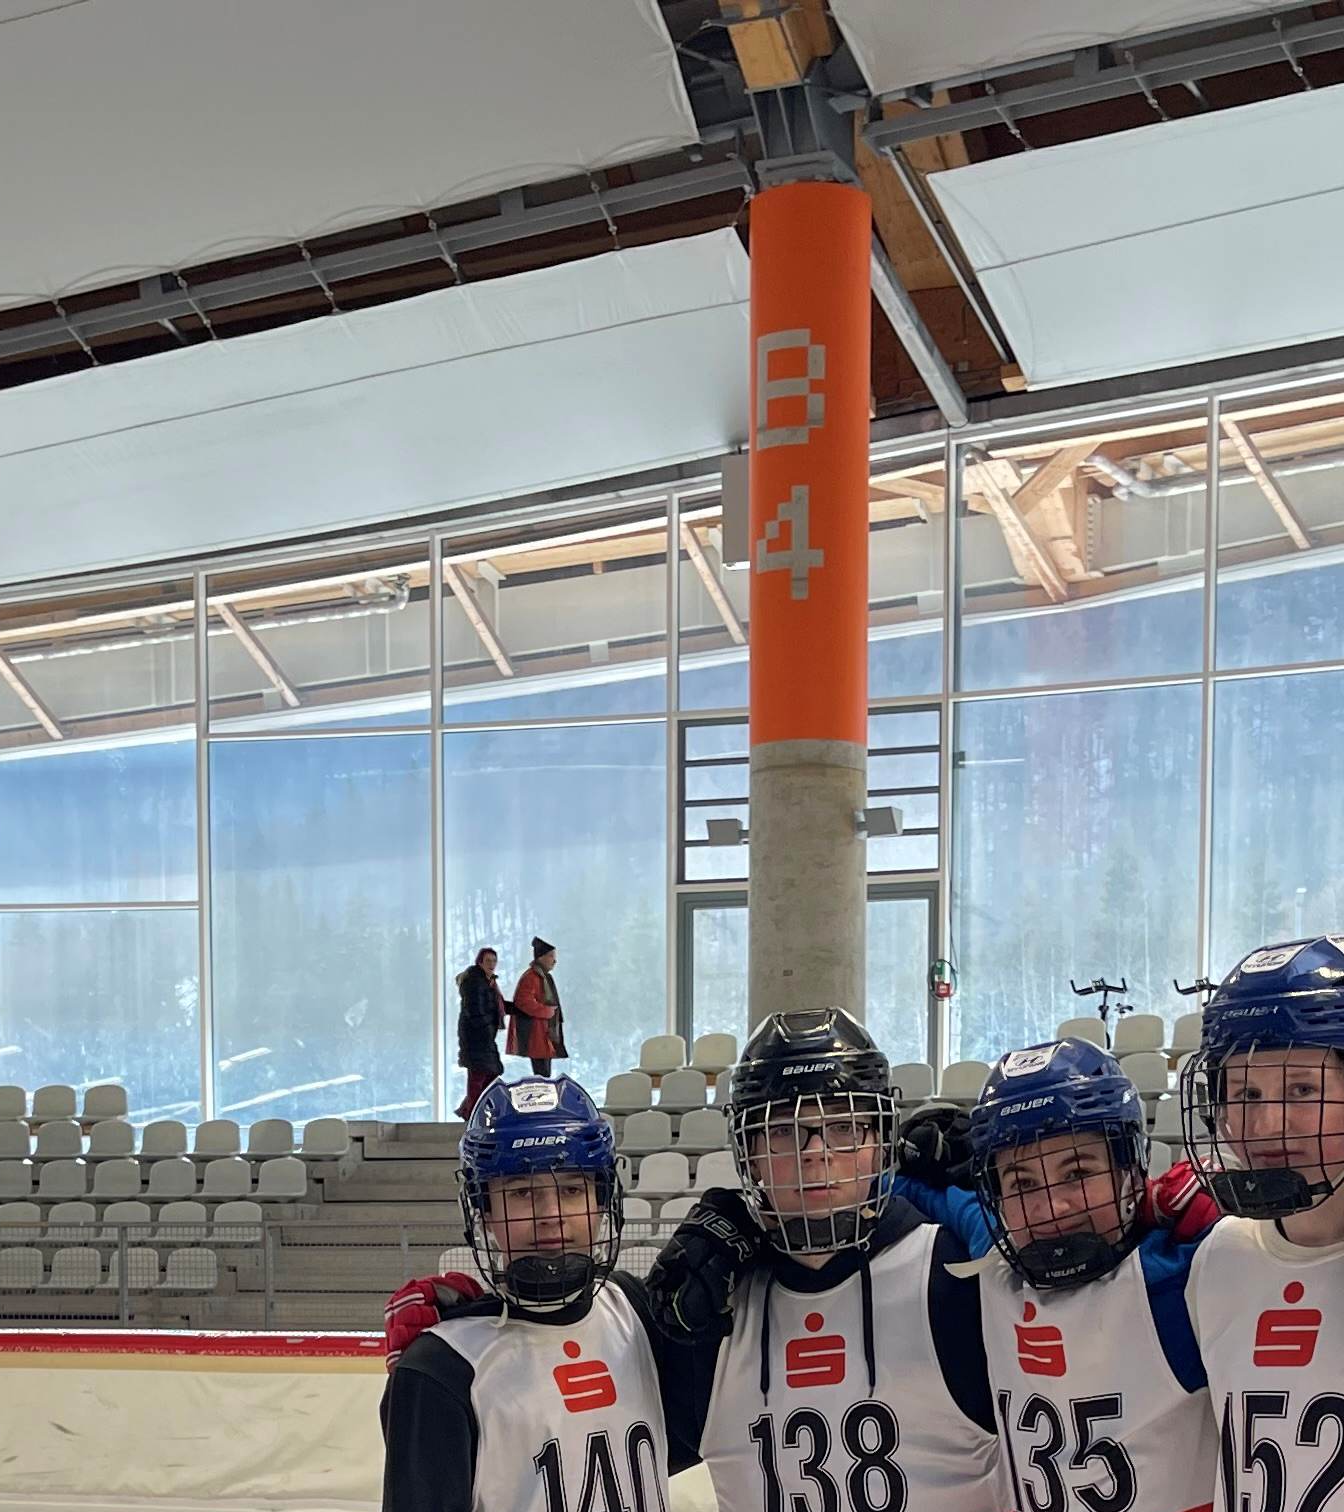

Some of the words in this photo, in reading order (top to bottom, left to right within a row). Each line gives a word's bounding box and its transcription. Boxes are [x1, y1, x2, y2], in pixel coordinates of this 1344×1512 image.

[782, 1061, 836, 1076] BAUER
[1000, 1095, 1055, 1117] BAUER
[511, 1135, 568, 1149] BAUER
